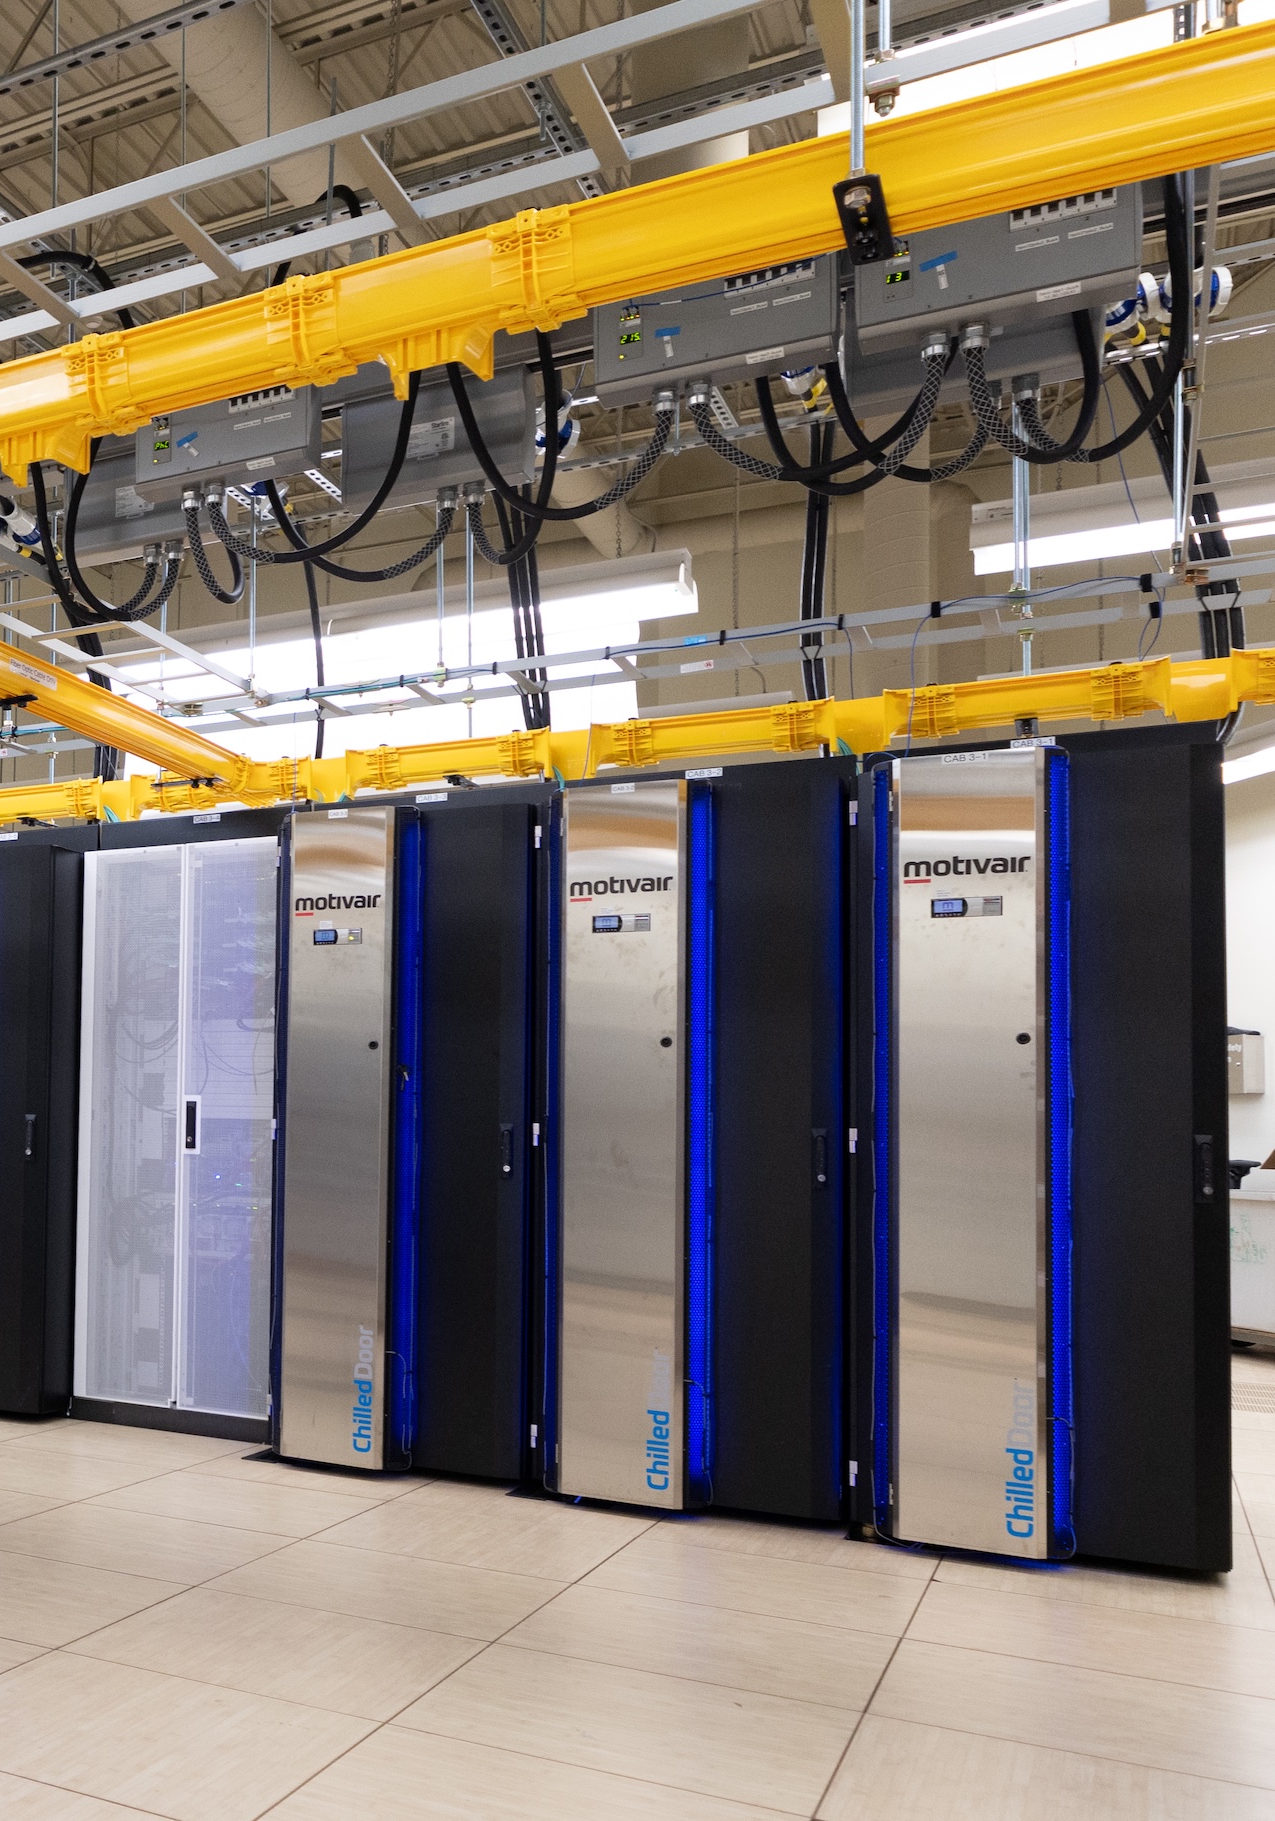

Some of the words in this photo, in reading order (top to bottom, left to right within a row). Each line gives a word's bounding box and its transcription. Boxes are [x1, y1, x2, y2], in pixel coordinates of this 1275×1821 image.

[1012, 740, 1034, 748] CAB
[1036, 738, 1053, 746] 3-1
[943, 754, 966, 763] CAB
[969, 753, 986, 761] 3-1
[707, 768, 722, 776] 3-2
[904, 856, 1031, 878] motivair
[570, 876, 673, 897] motivair
[295, 893, 381, 911] motivair
